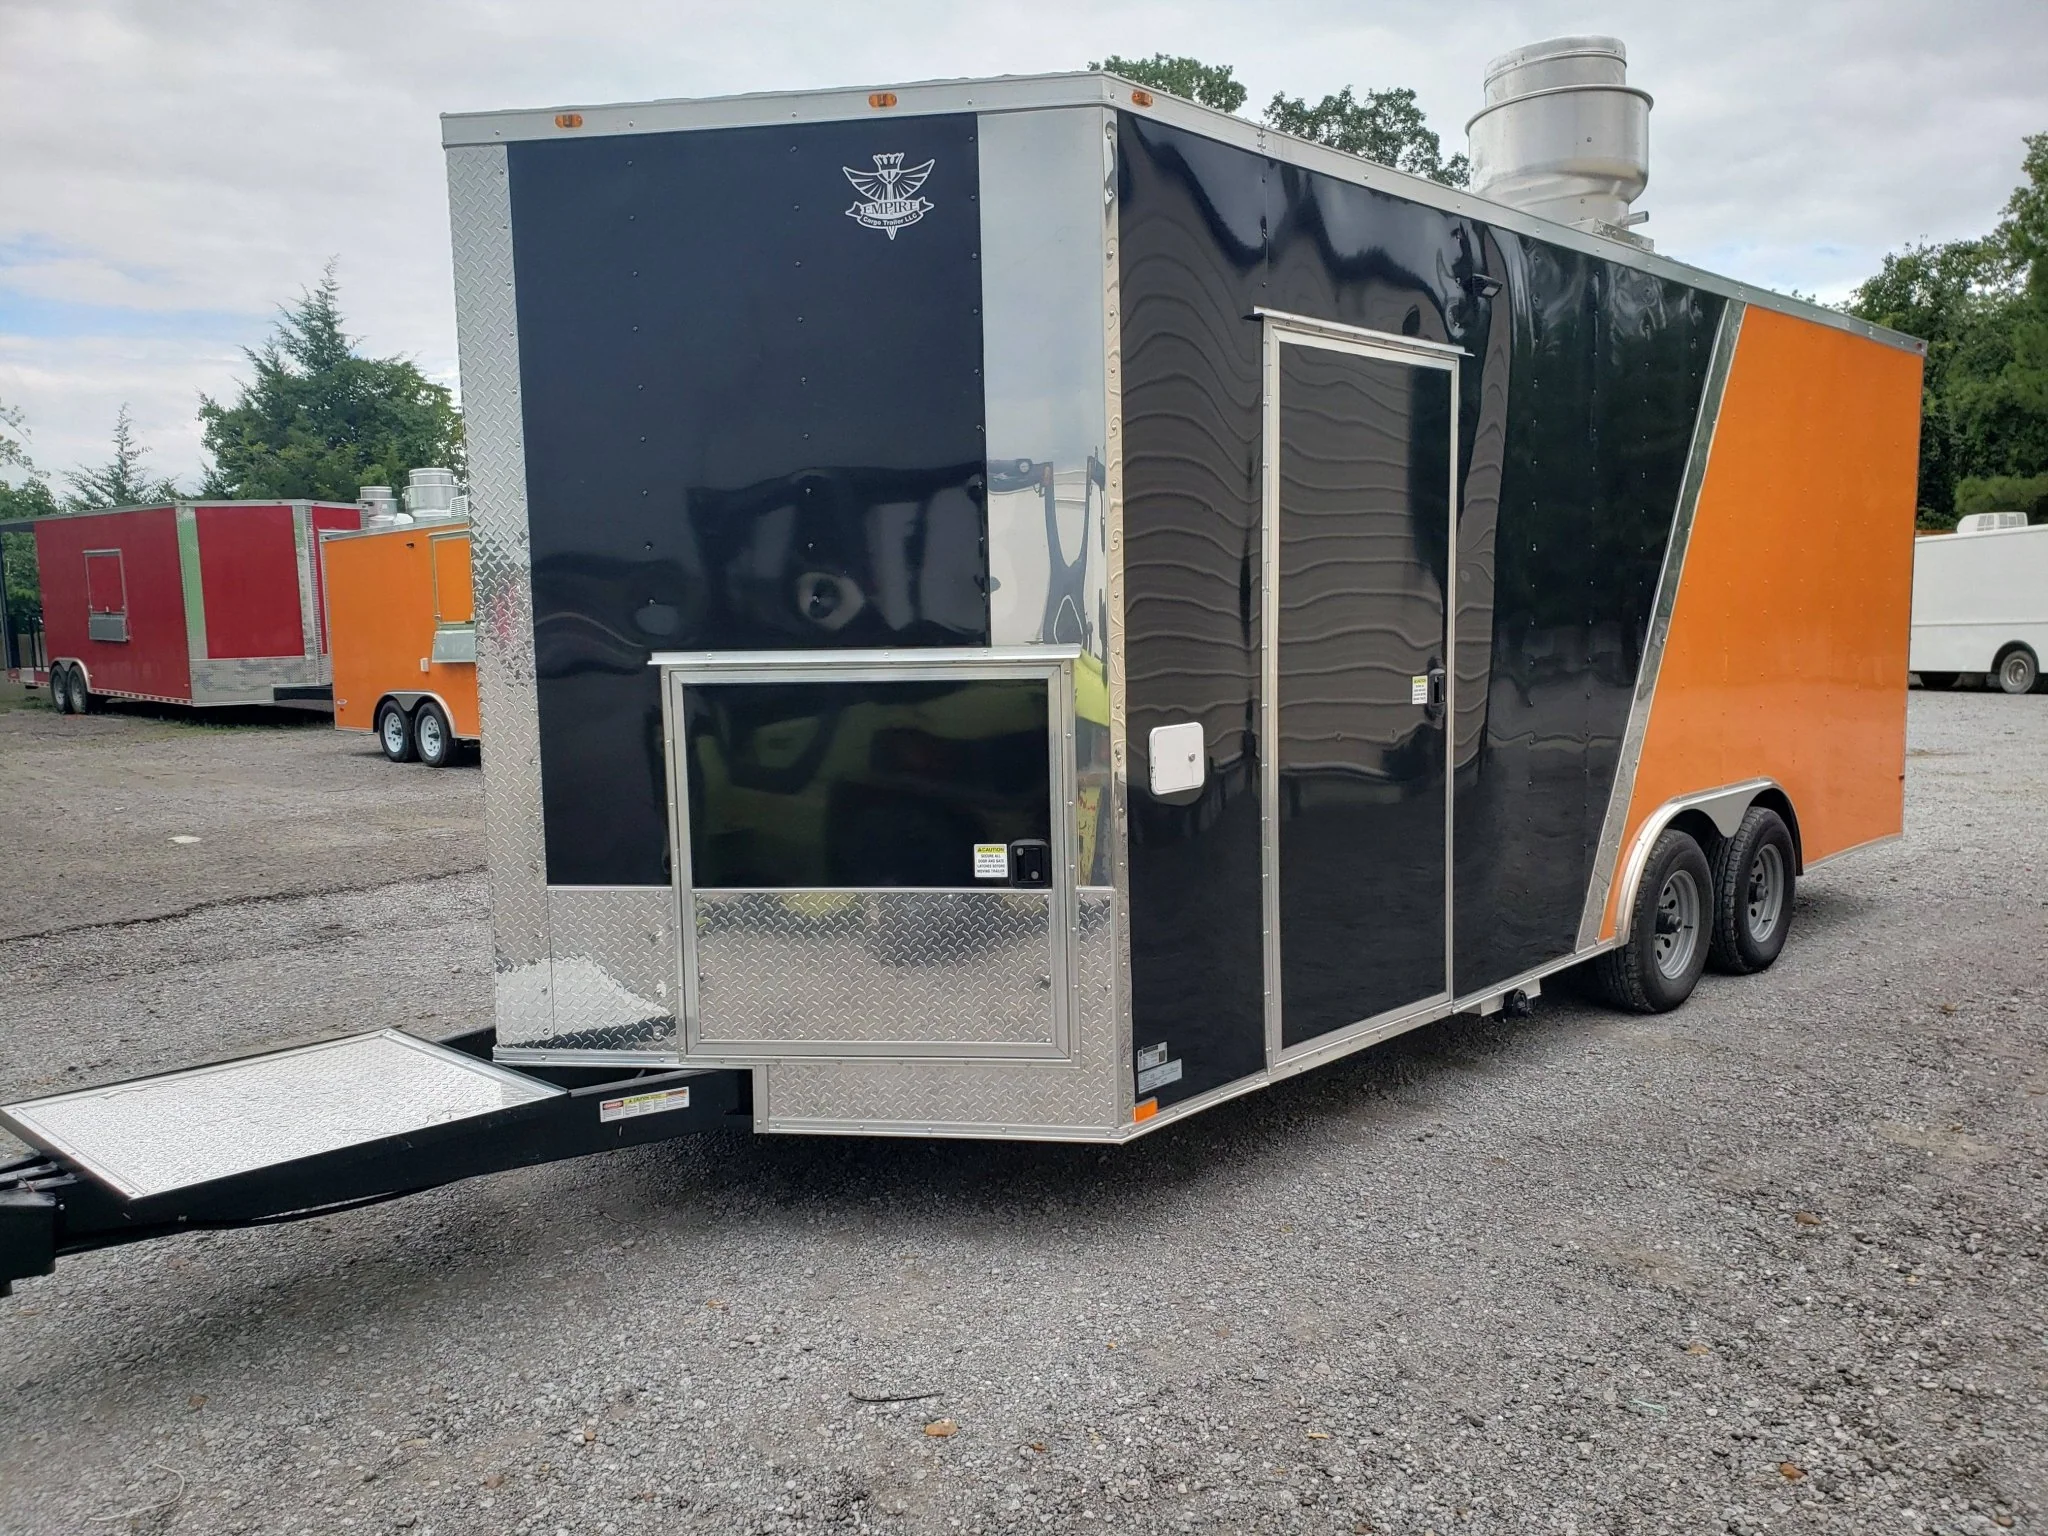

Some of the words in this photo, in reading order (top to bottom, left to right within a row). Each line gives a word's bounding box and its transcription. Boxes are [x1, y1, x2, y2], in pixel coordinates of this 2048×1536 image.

[863, 201, 917, 215] EMPIRE
[863, 216, 882, 226] Cargo
[904, 213, 918, 222] LLC
